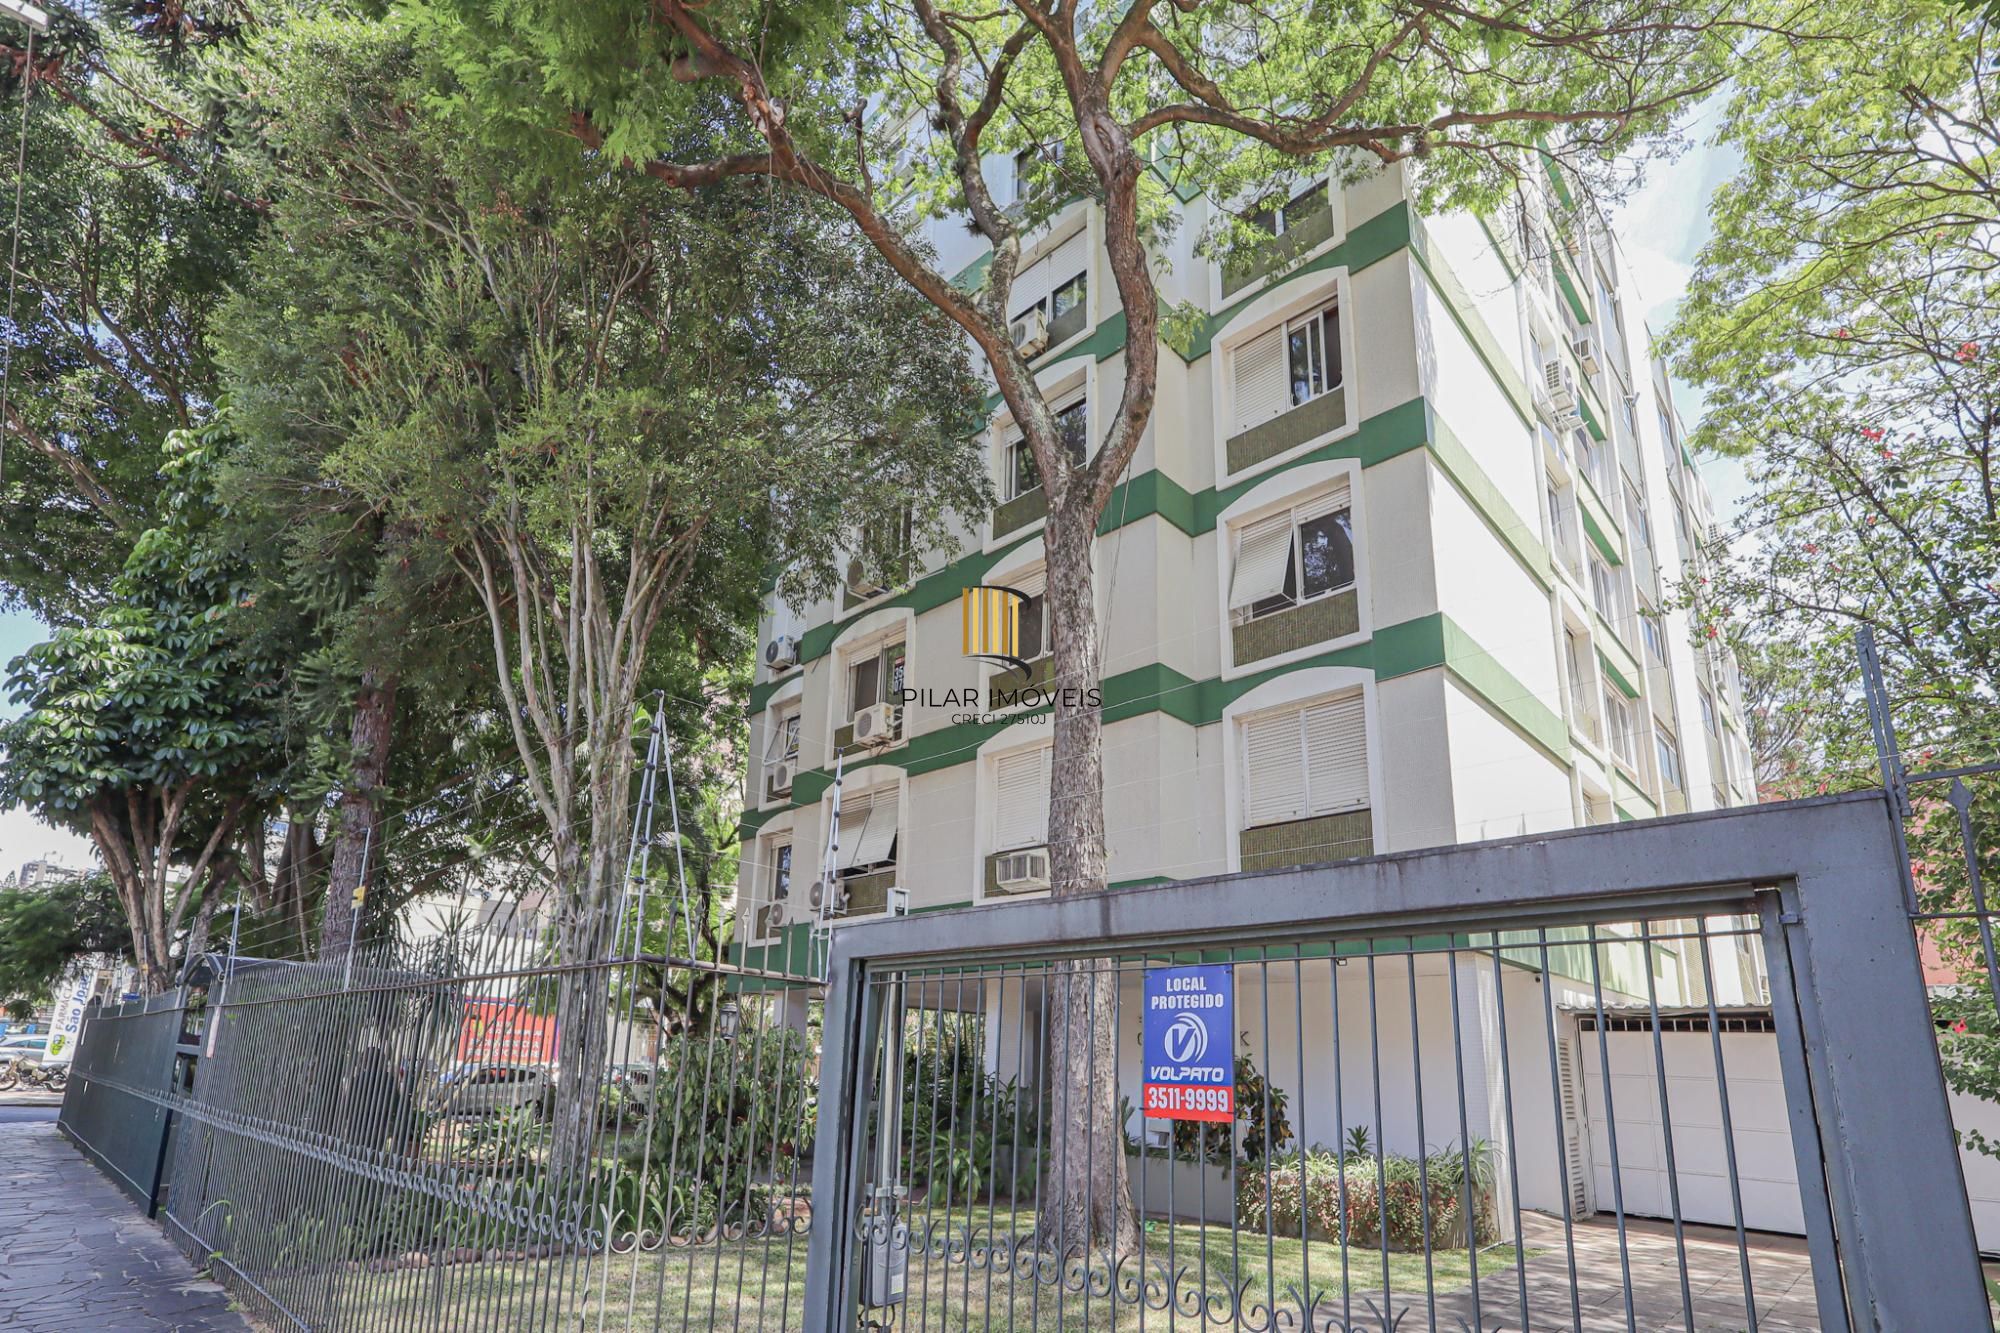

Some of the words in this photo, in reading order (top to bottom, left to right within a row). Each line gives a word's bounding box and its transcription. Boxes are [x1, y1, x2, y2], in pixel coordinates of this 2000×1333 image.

[1166, 976, 1207, 993] LOCAL
[1151, 993, 1224, 1010] PROTEGIDO
[1150, 1066, 1224, 1083] VOLPATO
[1148, 1087, 1228, 1112] 3511-9999
